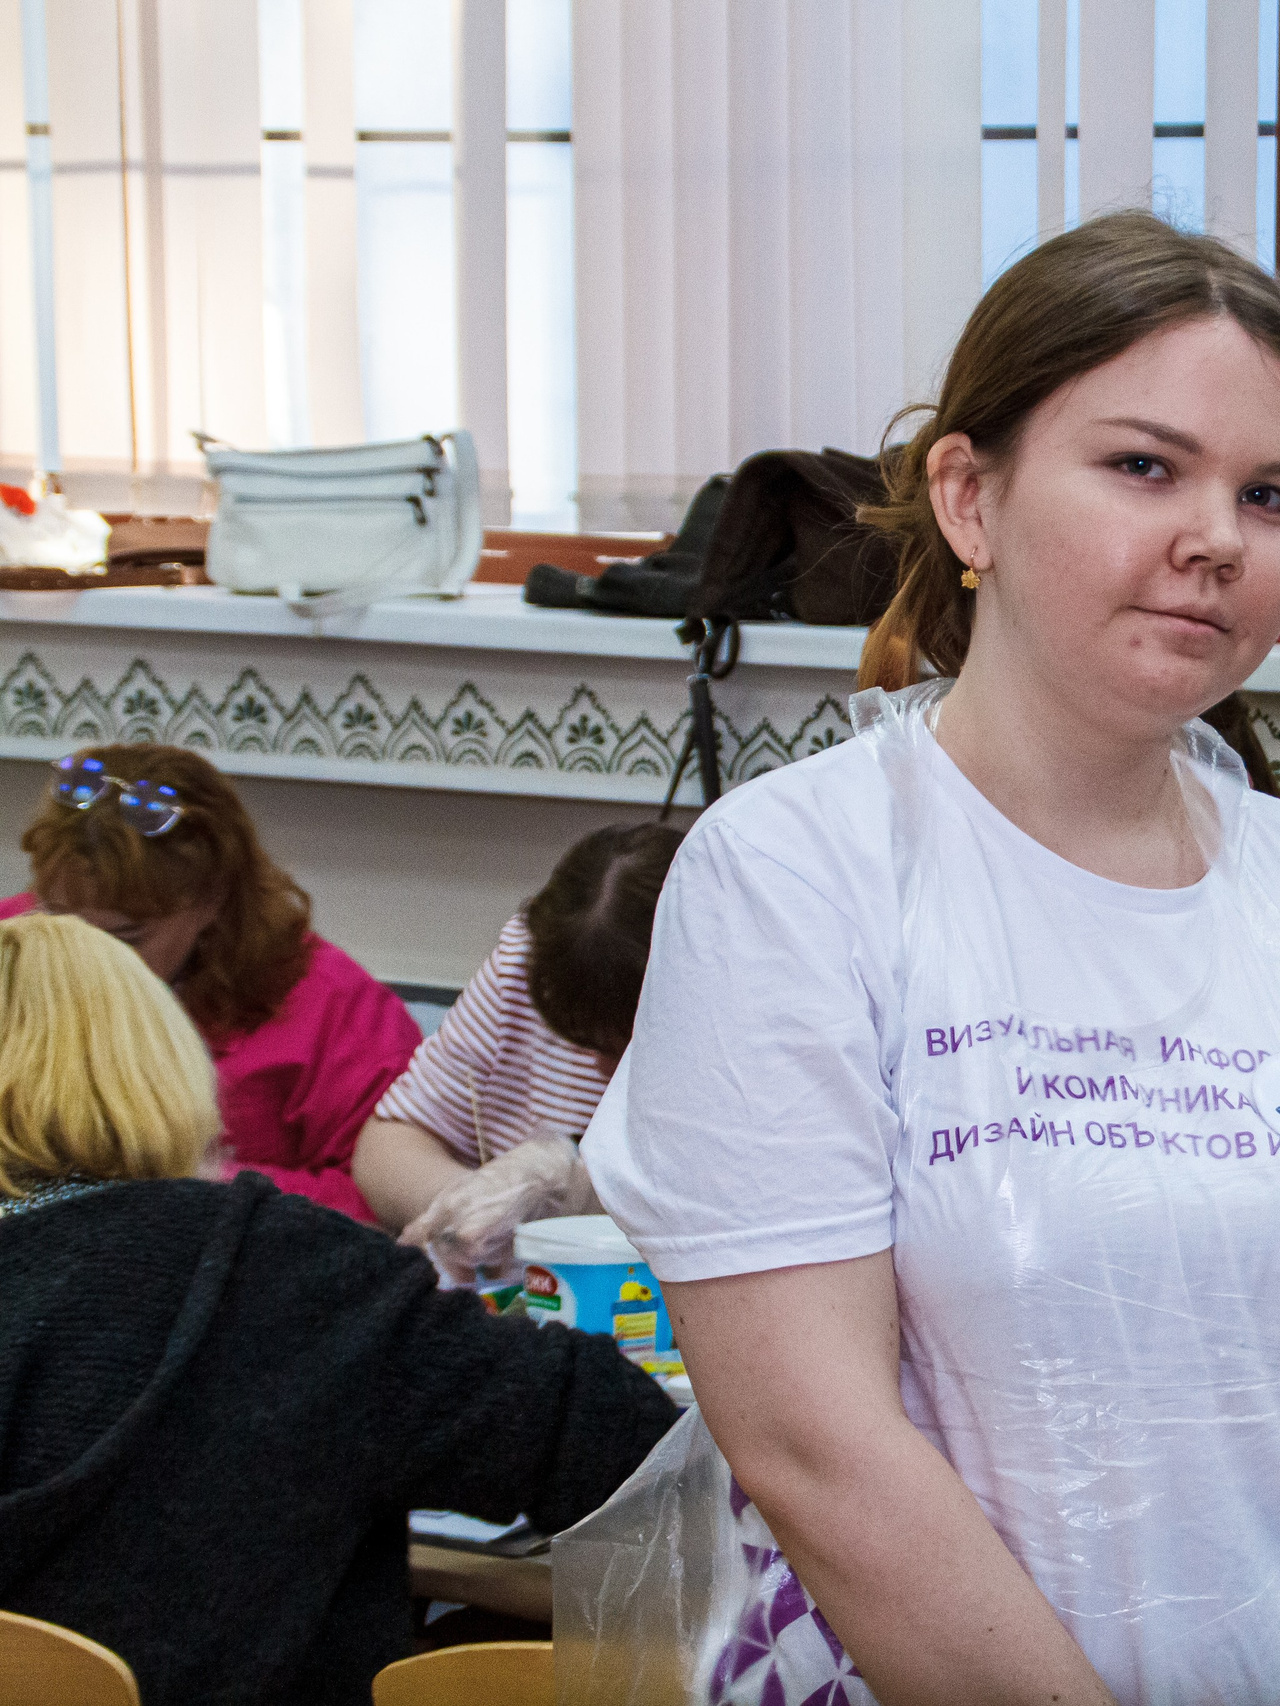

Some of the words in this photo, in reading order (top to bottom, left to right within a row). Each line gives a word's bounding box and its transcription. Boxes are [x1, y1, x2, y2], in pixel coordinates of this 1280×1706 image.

[1042, 1074, 1257, 1114] КОММУНИКА
[929, 1111, 1075, 1166] ДИЗАЙН
[1084, 1120, 1258, 1160] ОБЪКТОВ
